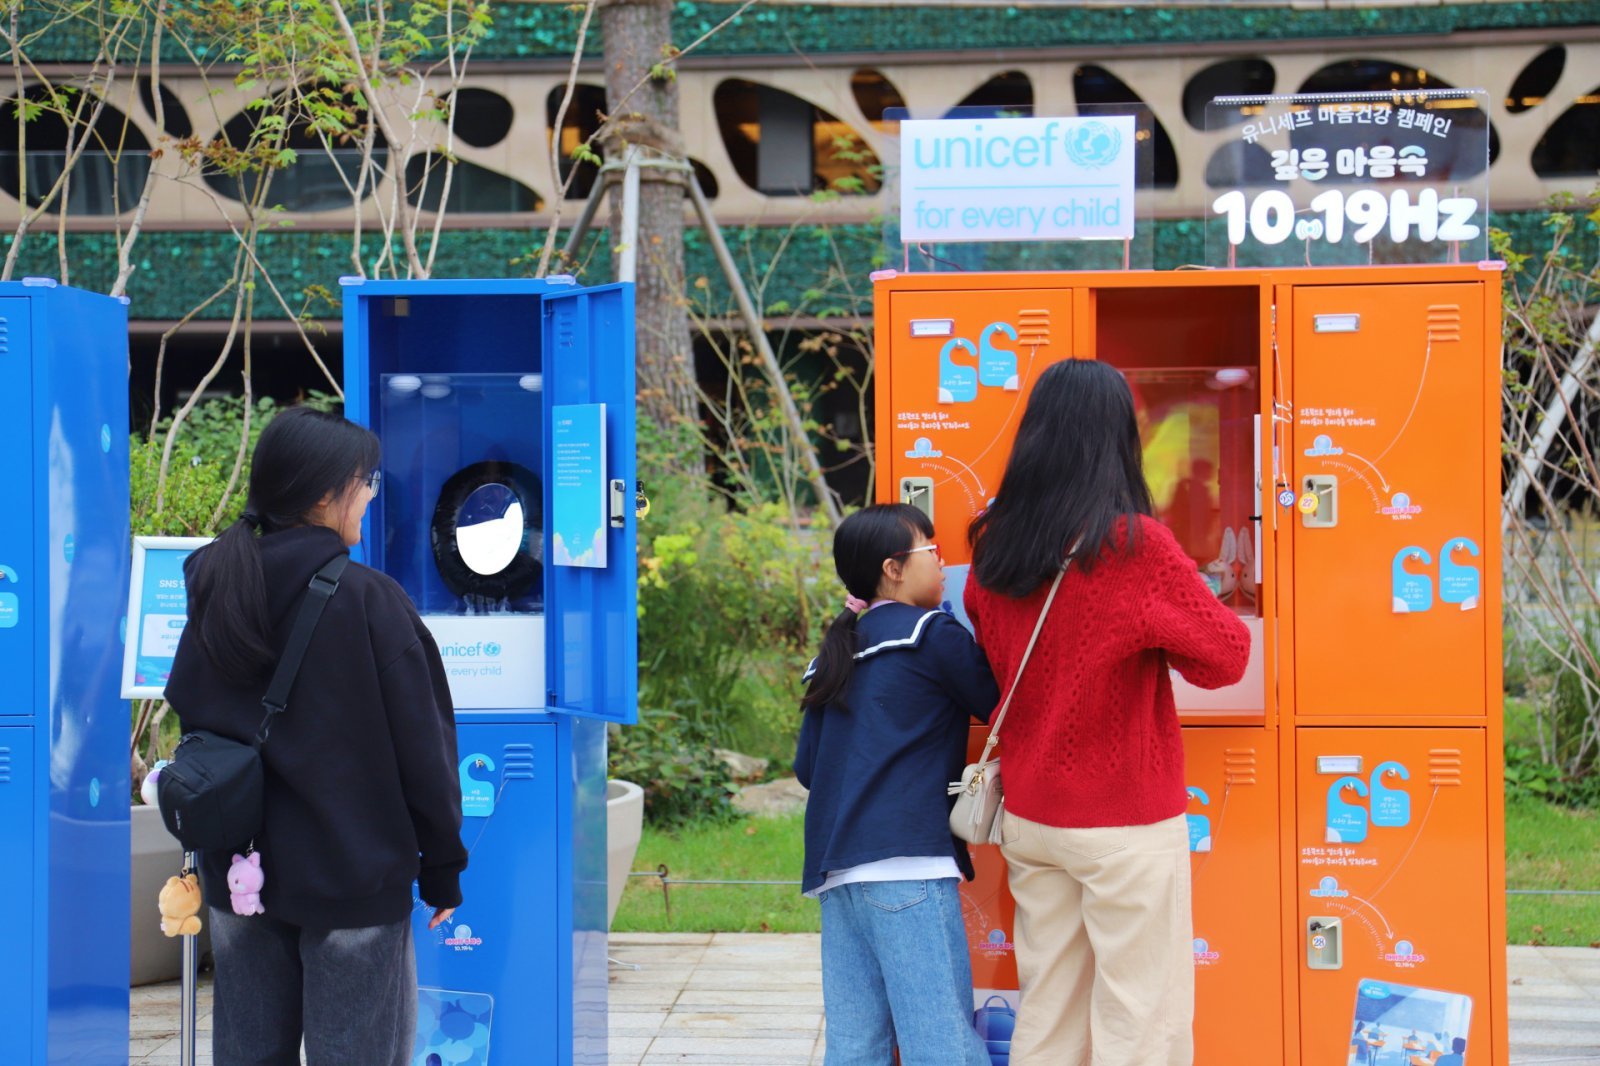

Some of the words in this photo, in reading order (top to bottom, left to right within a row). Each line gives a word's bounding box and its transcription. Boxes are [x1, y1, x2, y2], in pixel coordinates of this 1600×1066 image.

[1242, 109, 1314, 145] 유니세프
[1318, 104, 1392, 125] 마음건강
[1396, 106, 1452, 138] 캠페인
[914, 122, 1059, 169] unicef
[1270, 148, 1330, 181] 깊은
[1336, 145, 1428, 178] 마음속
[914, 200, 955, 229] for
[962, 206, 1046, 234] every
[1053, 198, 1121, 228] child
[1279, 493, 1292, 505] 25
[1302, 498, 1313, 508] 27
[159, 579, 178, 588] SNS
[451, 667, 478, 676] every
[480, 665, 502, 675] child
[1313, 937, 1325, 947] 28
